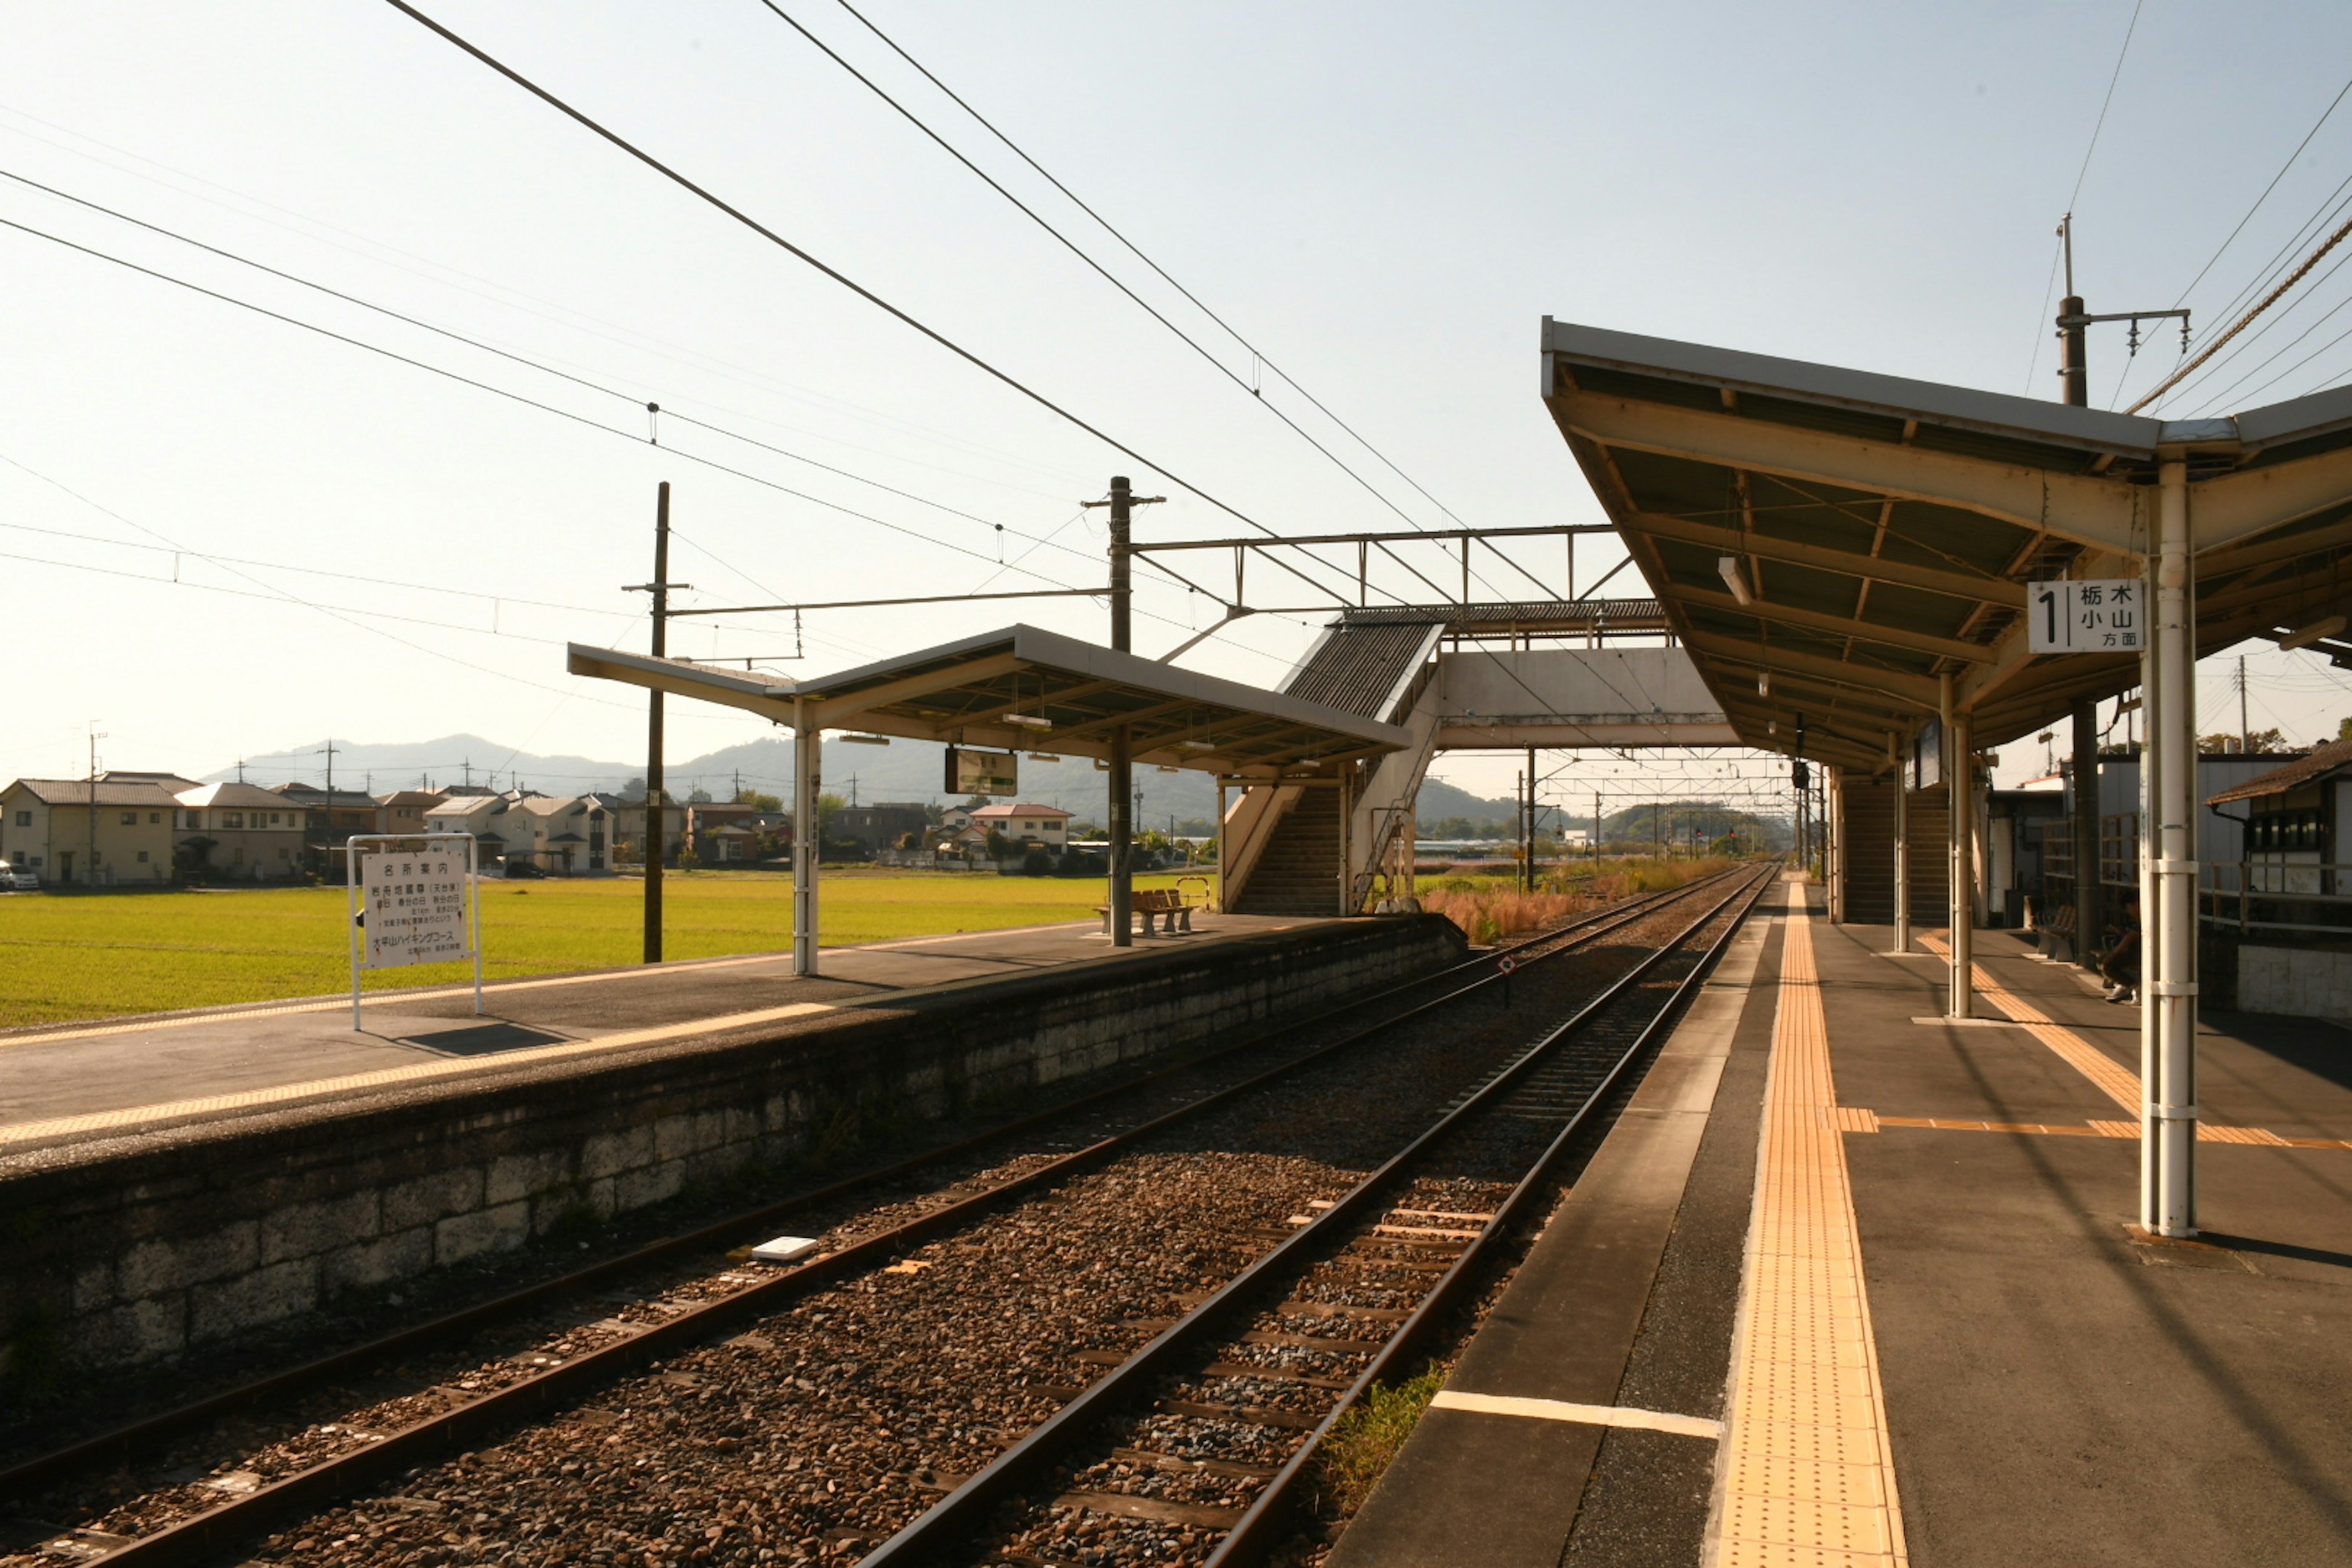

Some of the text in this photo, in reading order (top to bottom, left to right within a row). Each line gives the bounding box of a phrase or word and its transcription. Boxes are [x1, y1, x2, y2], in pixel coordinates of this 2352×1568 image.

[2081, 585, 2132, 605] 栃木
[2038, 590, 2055, 643] 1
[2081, 609, 2132, 629] 小山
[2103, 633, 2136, 646] 方面
[384, 862, 448, 876] 名所案内
